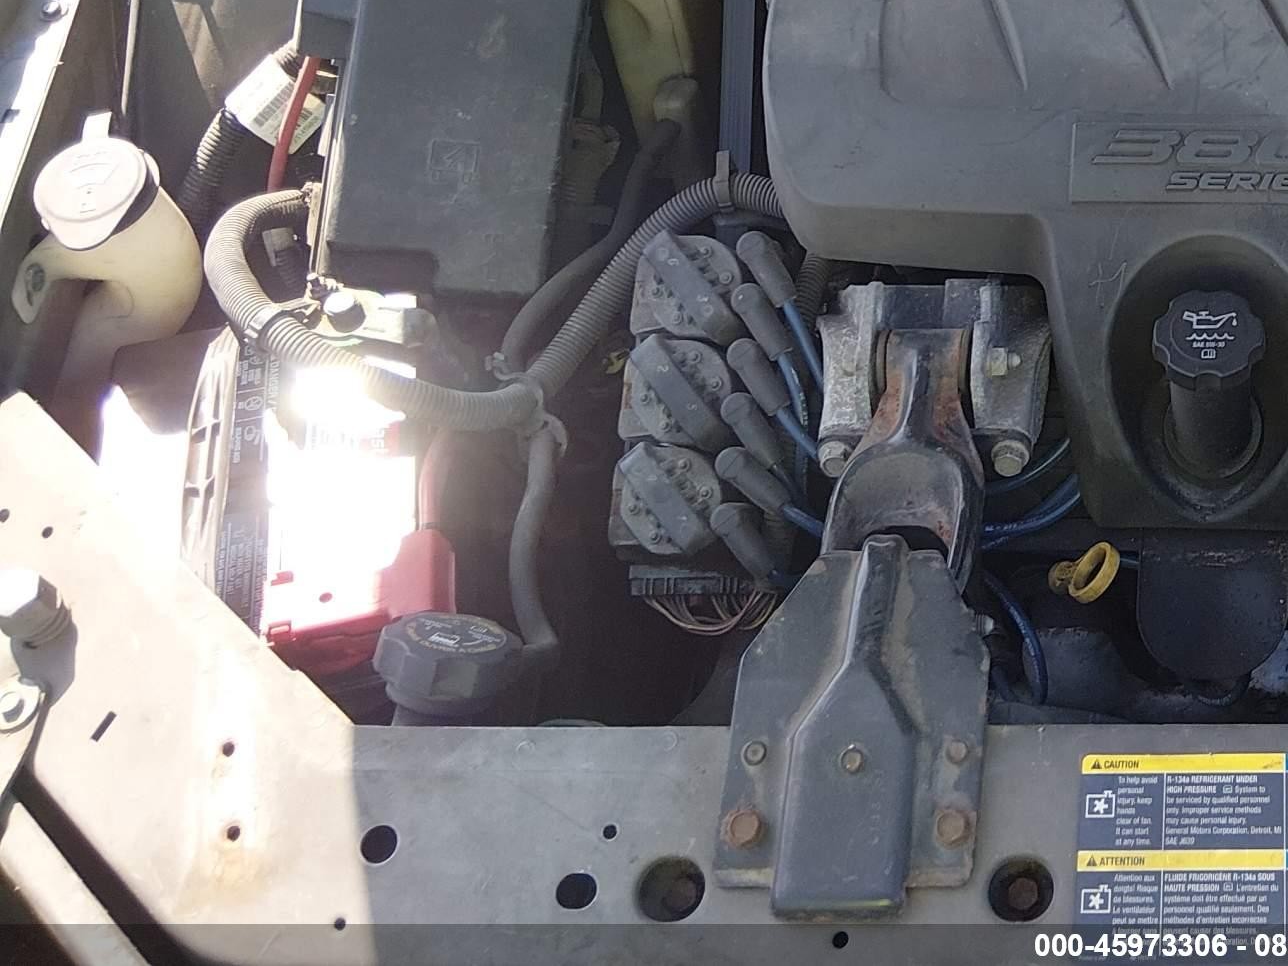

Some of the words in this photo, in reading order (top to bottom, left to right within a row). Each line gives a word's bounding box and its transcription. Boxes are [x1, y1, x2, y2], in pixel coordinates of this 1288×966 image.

[1104, 760, 1139, 769] CAUTION
[1126, 776, 1140, 786] help
[1141, 776, 1158, 784] avoid
[1167, 776, 1190, 784] R-134a
[1191, 776, 1234, 784] REFRIGERANT
[1236, 776, 1258, 784] UNDER
[1166, 786, 1182, 794] HIGH
[1184, 786, 1216, 794] PRESSURE
[1234, 786, 1258, 794] System
[1259, 786, 1266, 794] to
[1166, 796, 1174, 804] be
[1176, 796, 1202, 804] serviced
[1203, 796, 1210, 804] by
[1212, 796, 1238, 804] qualified
[1240, 796, 1270, 804] personnel
[1210, 806, 1234, 814] service
[1234, 806, 1262, 814] methods
[1166, 817, 1180, 825] may
[1180, 817, 1199, 825] cause
[1200, 817, 1228, 825] personal
[1166, 826, 1188, 835] General
[1190, 826, 1212, 835] Motors
[1115, 838, 1122, 846] at
[1122, 838, 1134, 846] any
[1166, 837, 1178, 845] SAE
[1100, 857, 1145, 866] ATTENTION
[1114, 874, 1142, 882] Attention
[1144, 874, 1155, 882] aux
[1164, 872, 1187, 882] FLUIDE
[1232, 872, 1256, 882] R-134a
[1258, 872, 1276, 882] SOUS
[1164, 884, 1186, 892] HAUTE
[1187, 884, 1220, 892] PRESSION
[1270, 884, 1279, 892] du
[1113, 896, 1122, 904] de
[1192, 895, 1204, 904] doit
[1246, 895, 1257, 904] par
[1258, 895, 1267, 904] un
[1112, 906, 1120, 914] Le
[1258, 906, 1270, 914] Des
